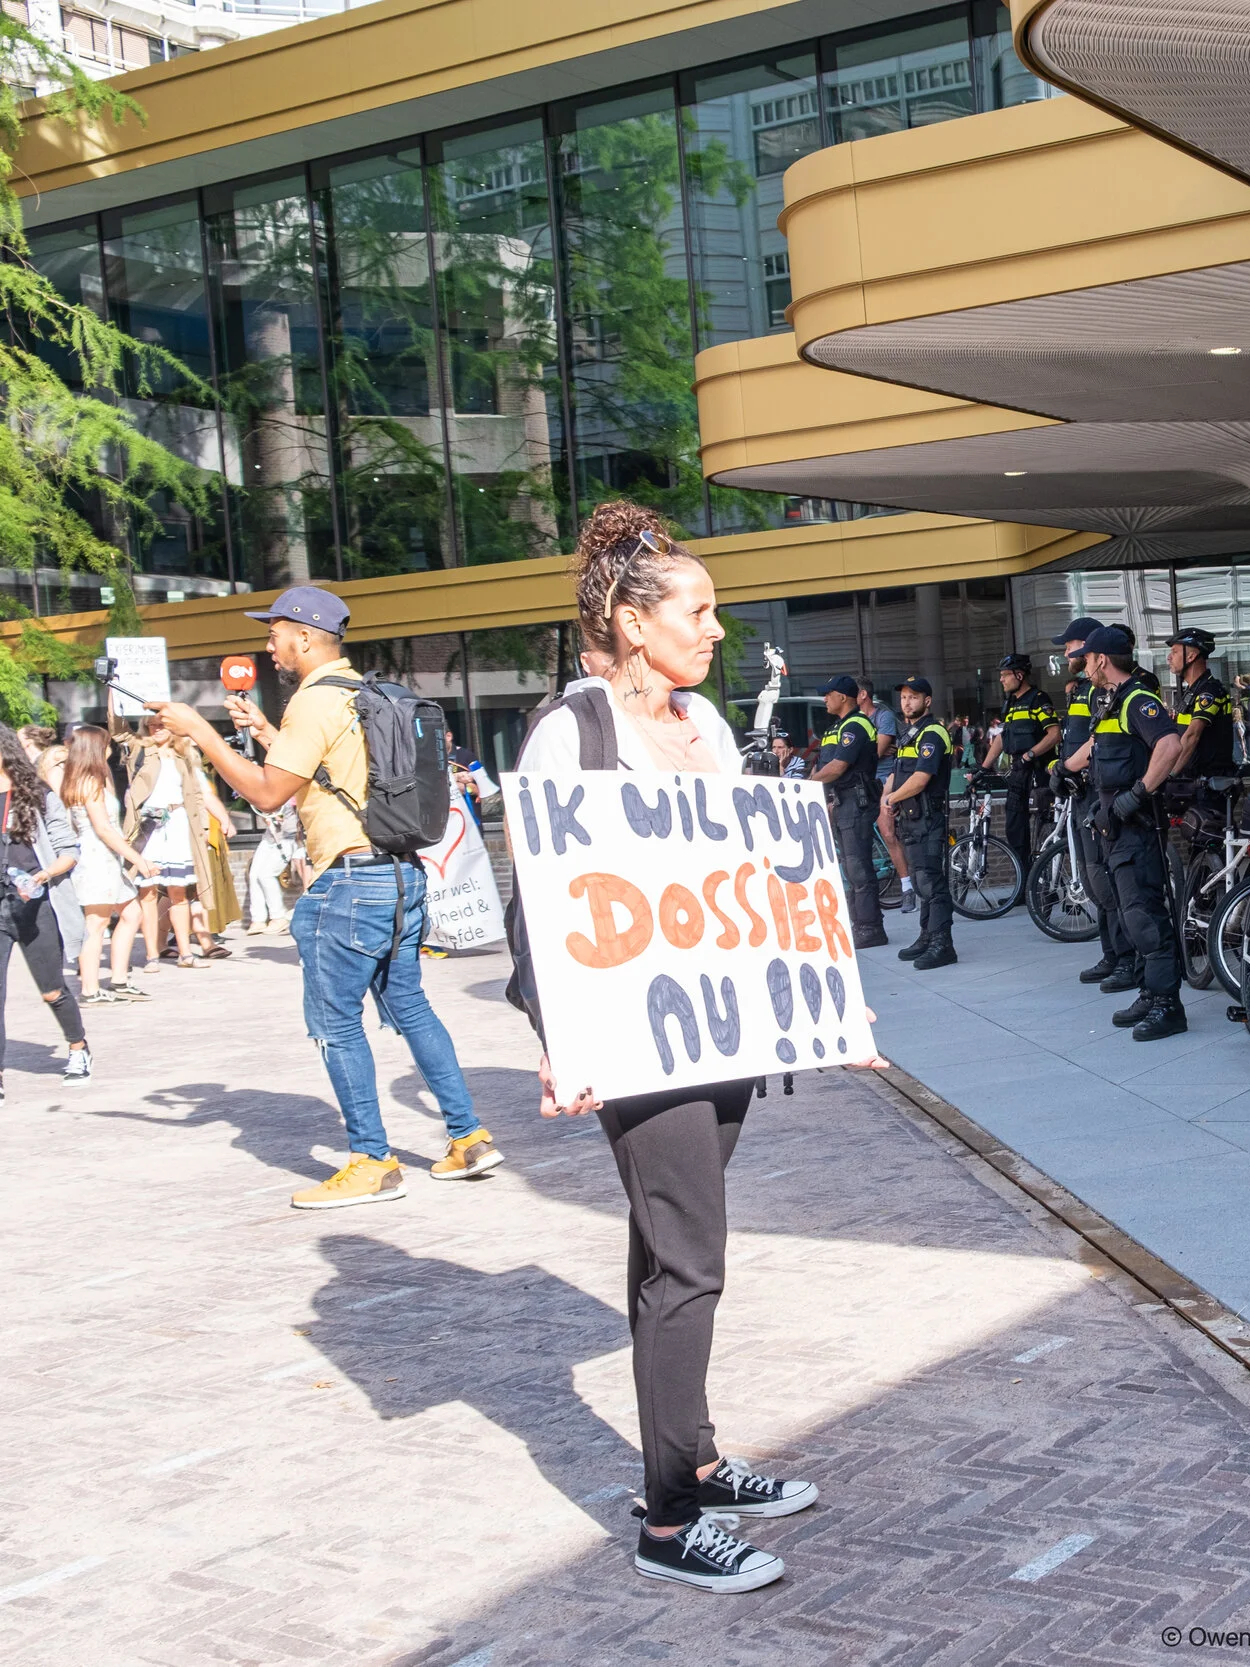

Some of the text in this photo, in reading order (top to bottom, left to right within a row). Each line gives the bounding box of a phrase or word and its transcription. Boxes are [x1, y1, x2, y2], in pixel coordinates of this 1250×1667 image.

[425, 877, 481, 903] aar wel:
[429, 899, 491, 929] ijheid &
